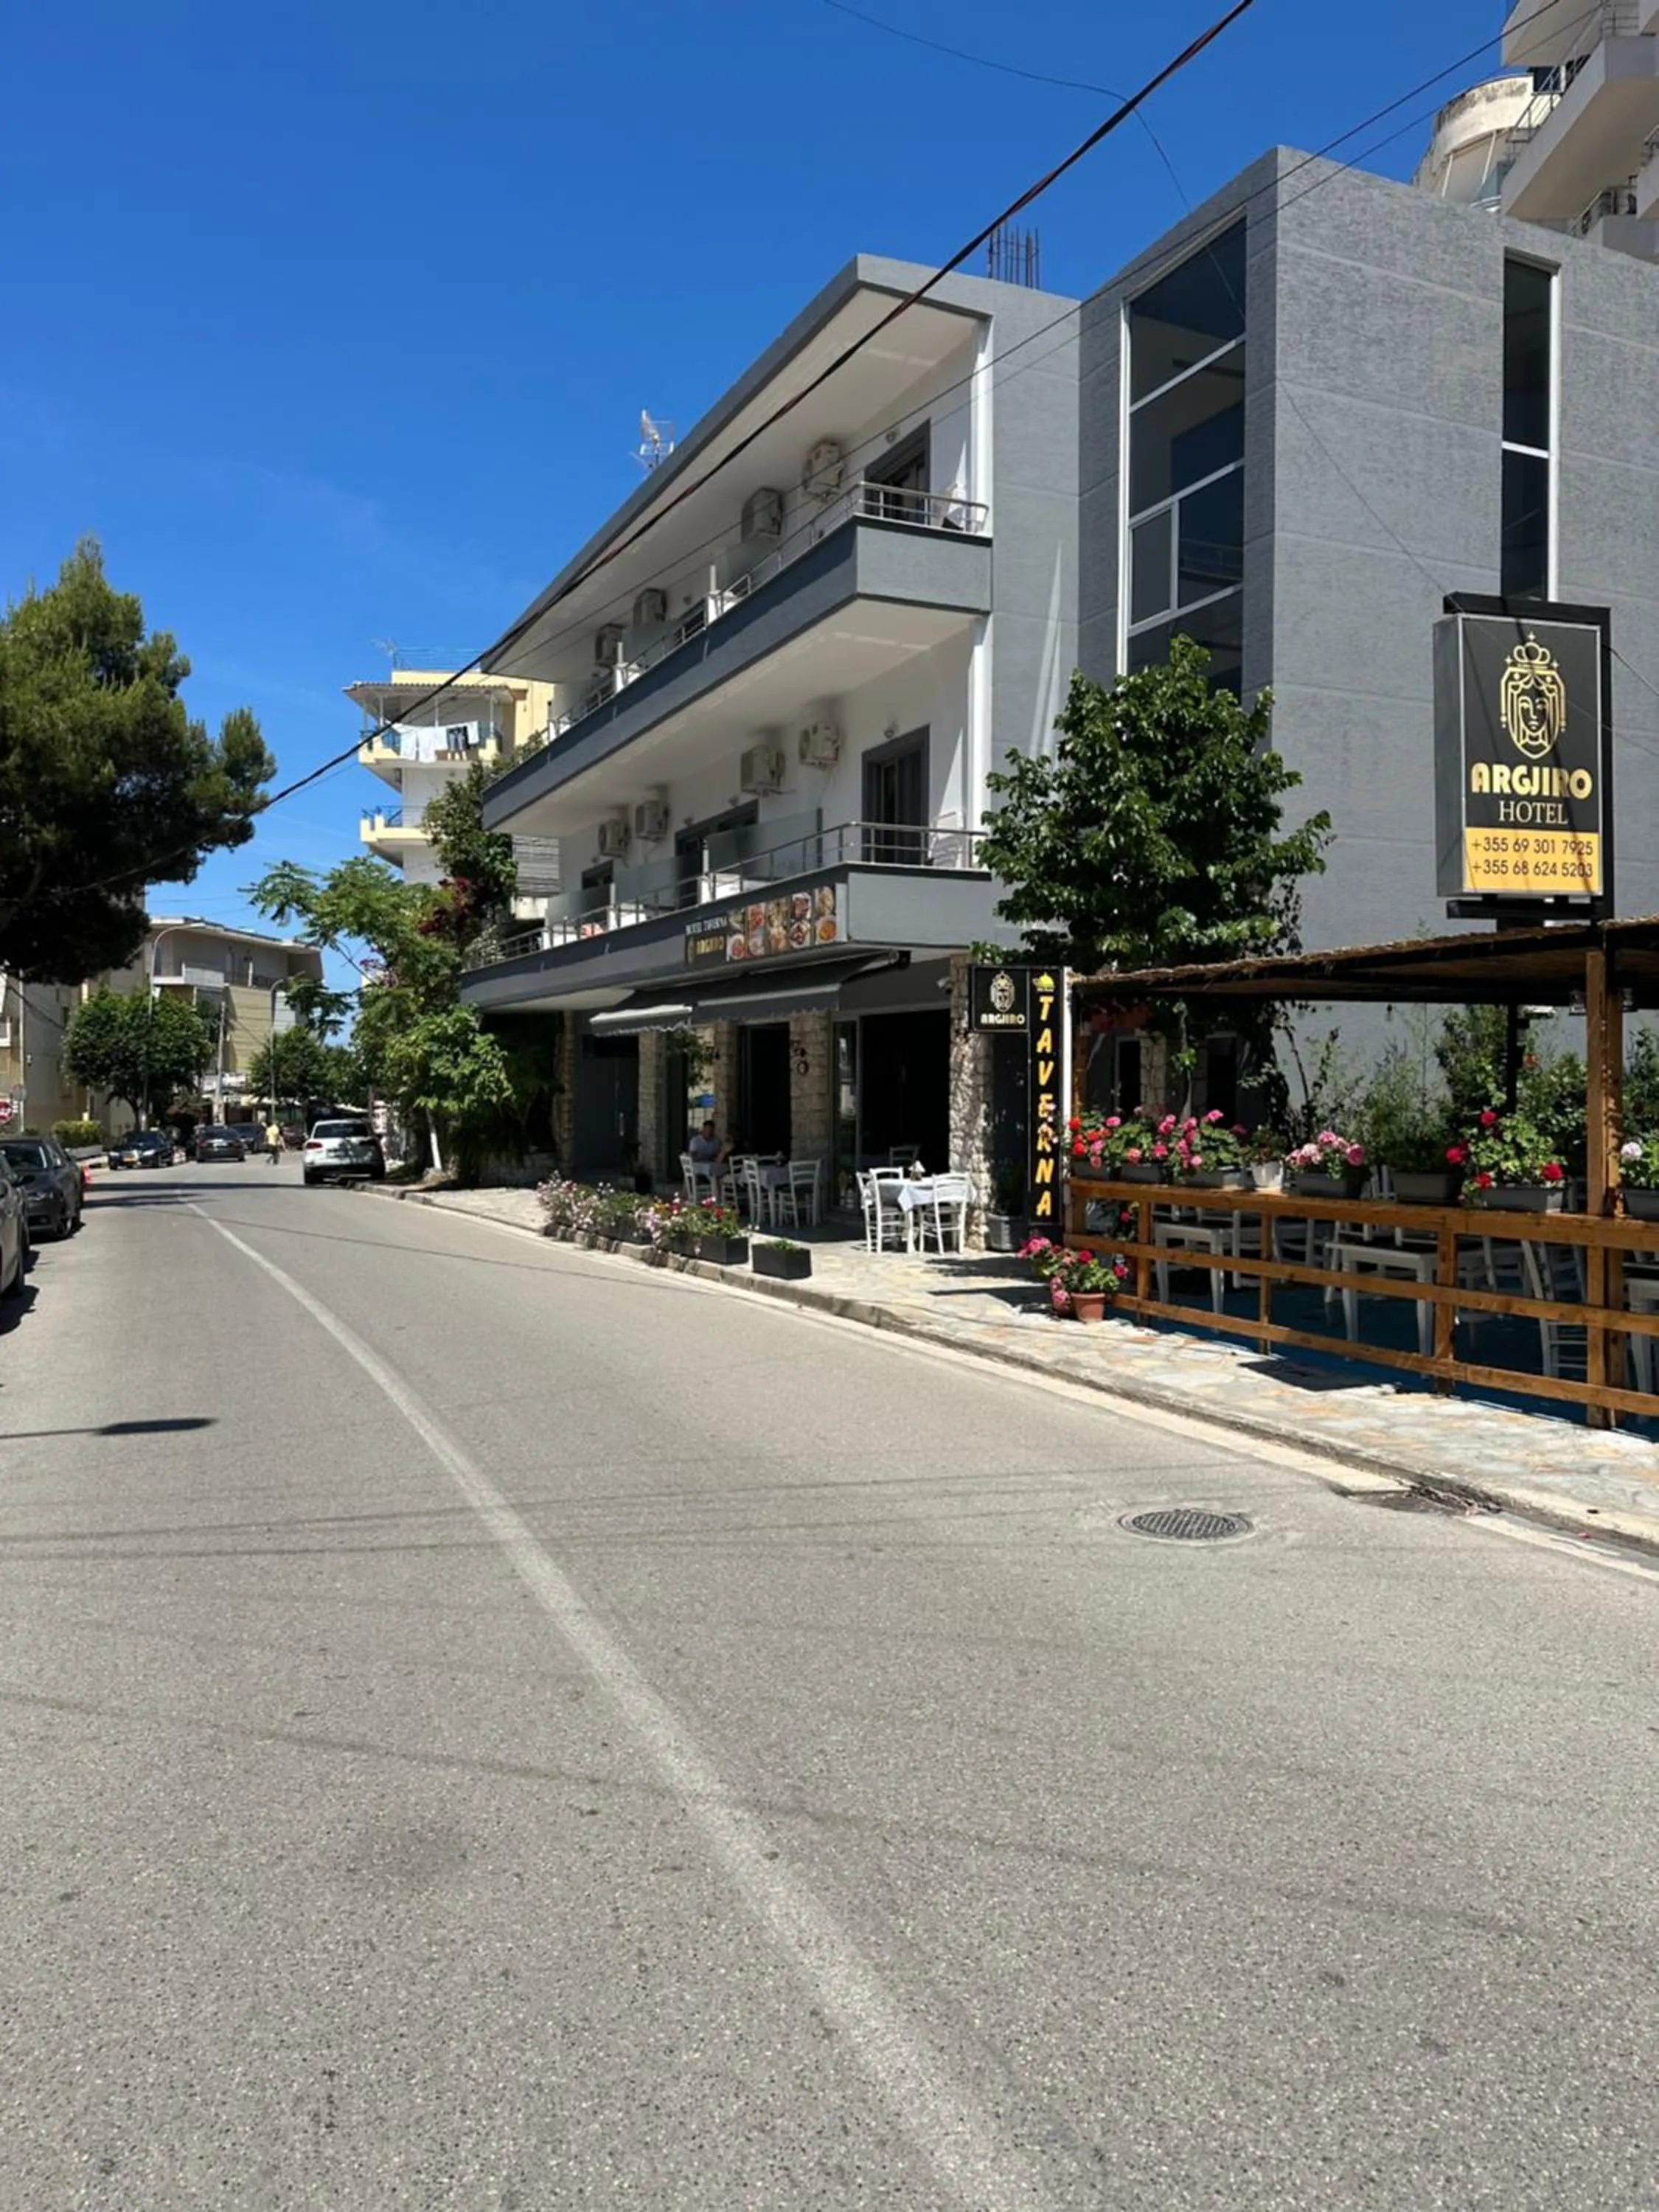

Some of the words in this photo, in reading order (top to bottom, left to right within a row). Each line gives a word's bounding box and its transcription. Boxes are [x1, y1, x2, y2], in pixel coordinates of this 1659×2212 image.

[1471, 762, 1593, 799] ARGJIRO
[1498, 800, 1568, 824] HOTEL
[1472, 836, 1509, 852] +355
[1512, 838, 1529, 853] 69
[1534, 839, 1556, 855] 301
[1562, 840, 1593, 855] 7925
[1472, 859, 1509, 874] +355
[1512, 860, 1529, 875] 68
[1533, 861, 1557, 876] 624
[1561, 862, 1593, 877] 5203
[1035, 995, 1054, 1216] TAVERNA
